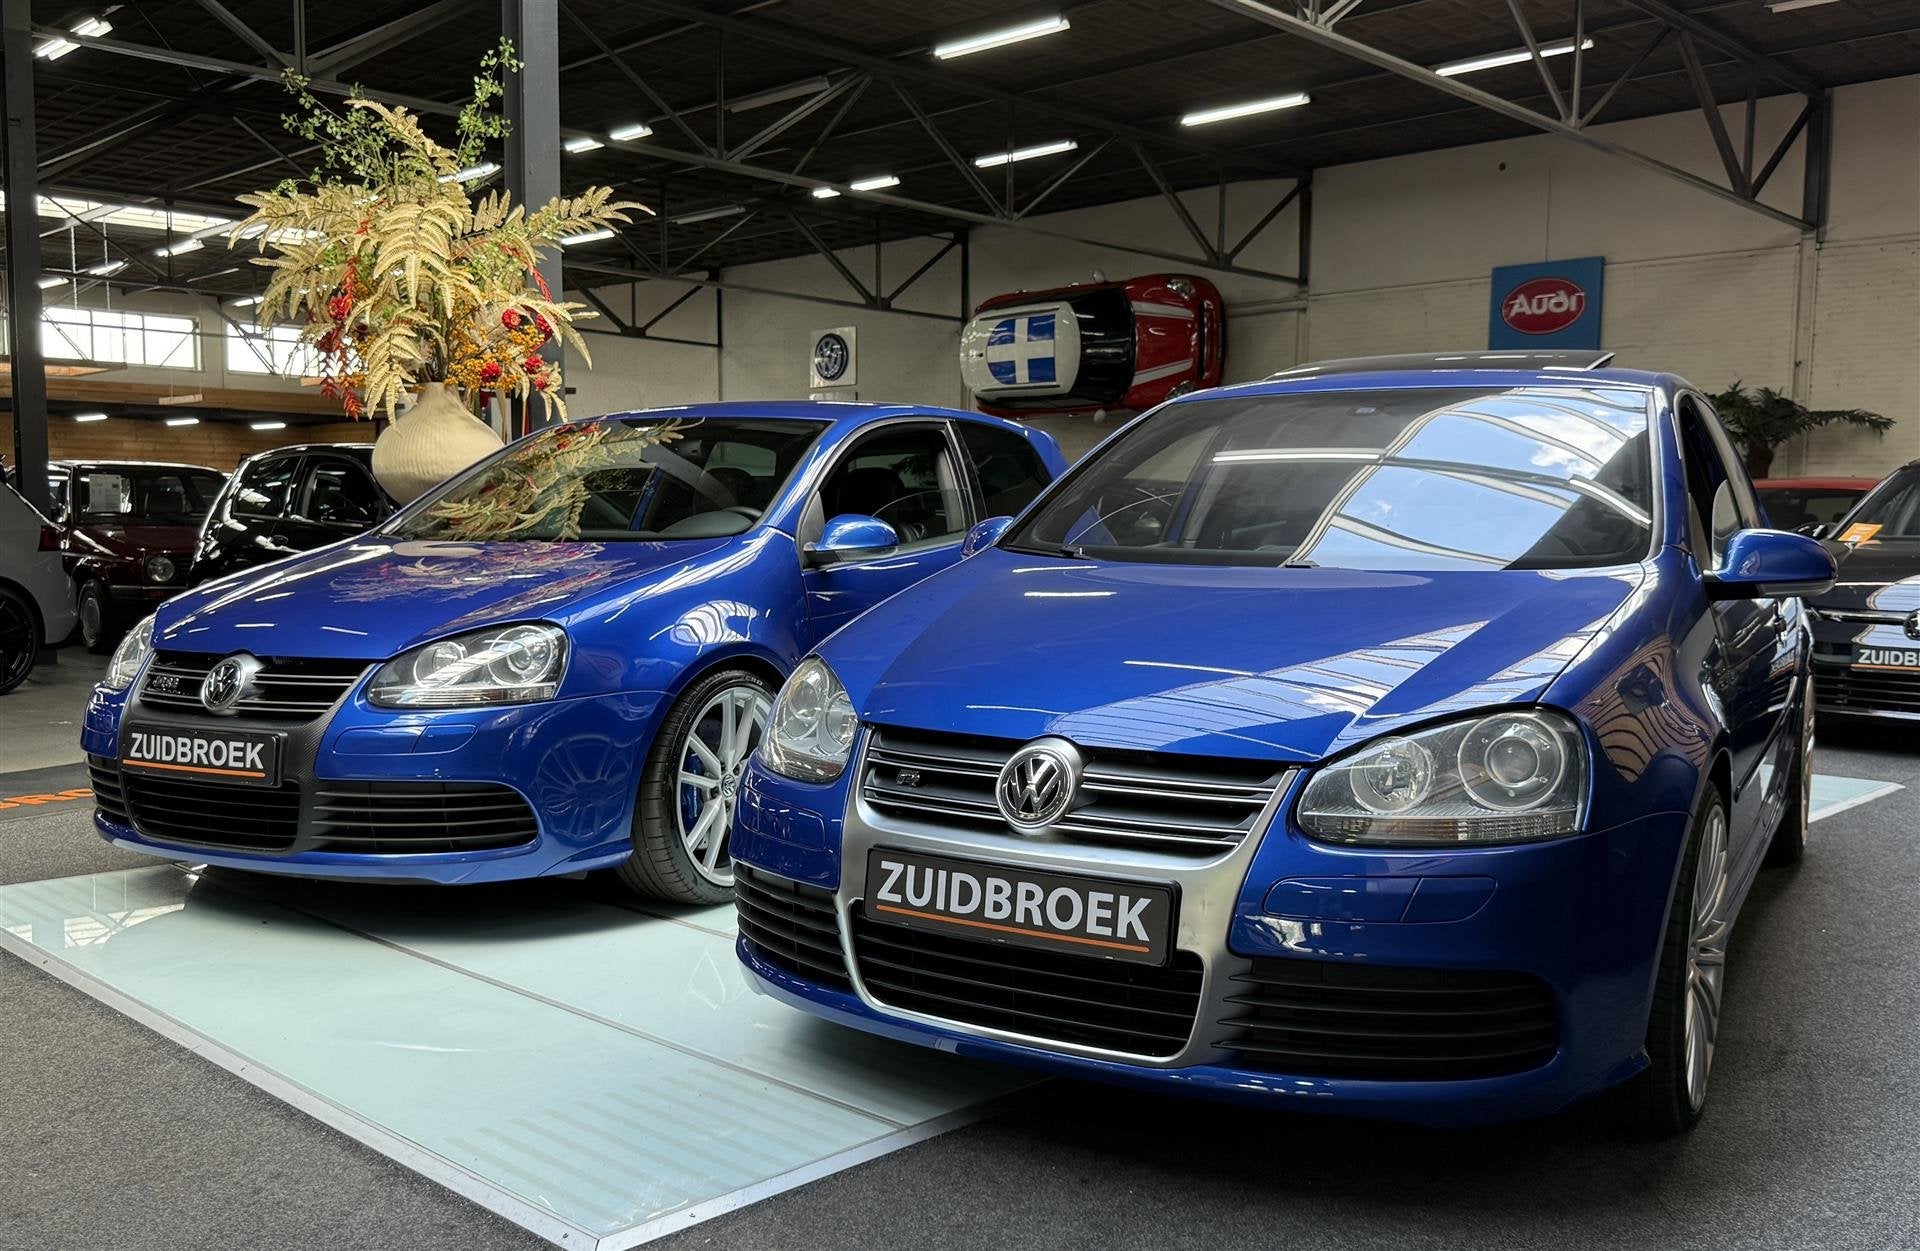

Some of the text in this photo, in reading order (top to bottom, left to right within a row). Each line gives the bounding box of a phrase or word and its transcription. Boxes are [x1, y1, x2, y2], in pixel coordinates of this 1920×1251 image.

[1858, 649, 1920, 666] ZUIDB
[129, 733, 265, 769] ZUIDBROEK
[877, 861, 1152, 942] ZUIDBROEK
